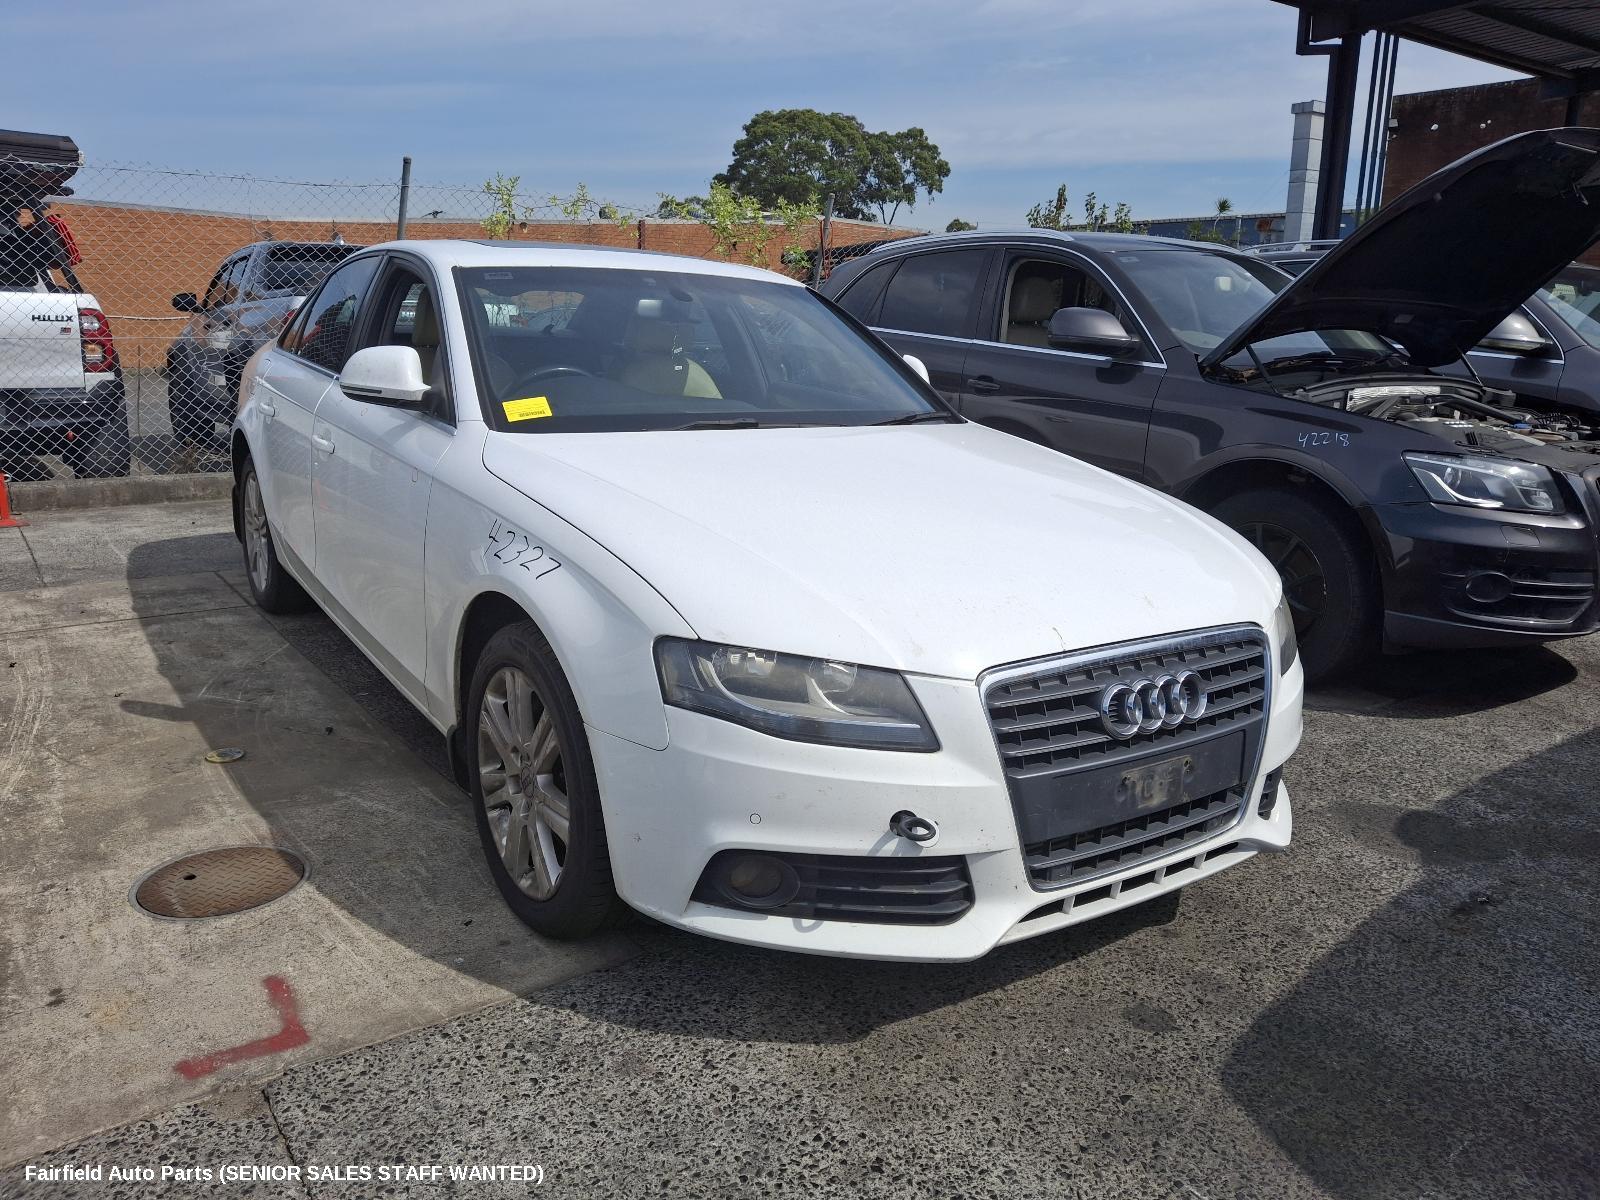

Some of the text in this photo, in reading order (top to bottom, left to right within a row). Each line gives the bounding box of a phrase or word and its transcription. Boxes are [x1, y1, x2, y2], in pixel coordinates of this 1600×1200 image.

[31, 314, 74, 322] HILUX
[1298, 432, 1350, 448] 42218
[483, 518, 562, 580] 42327
